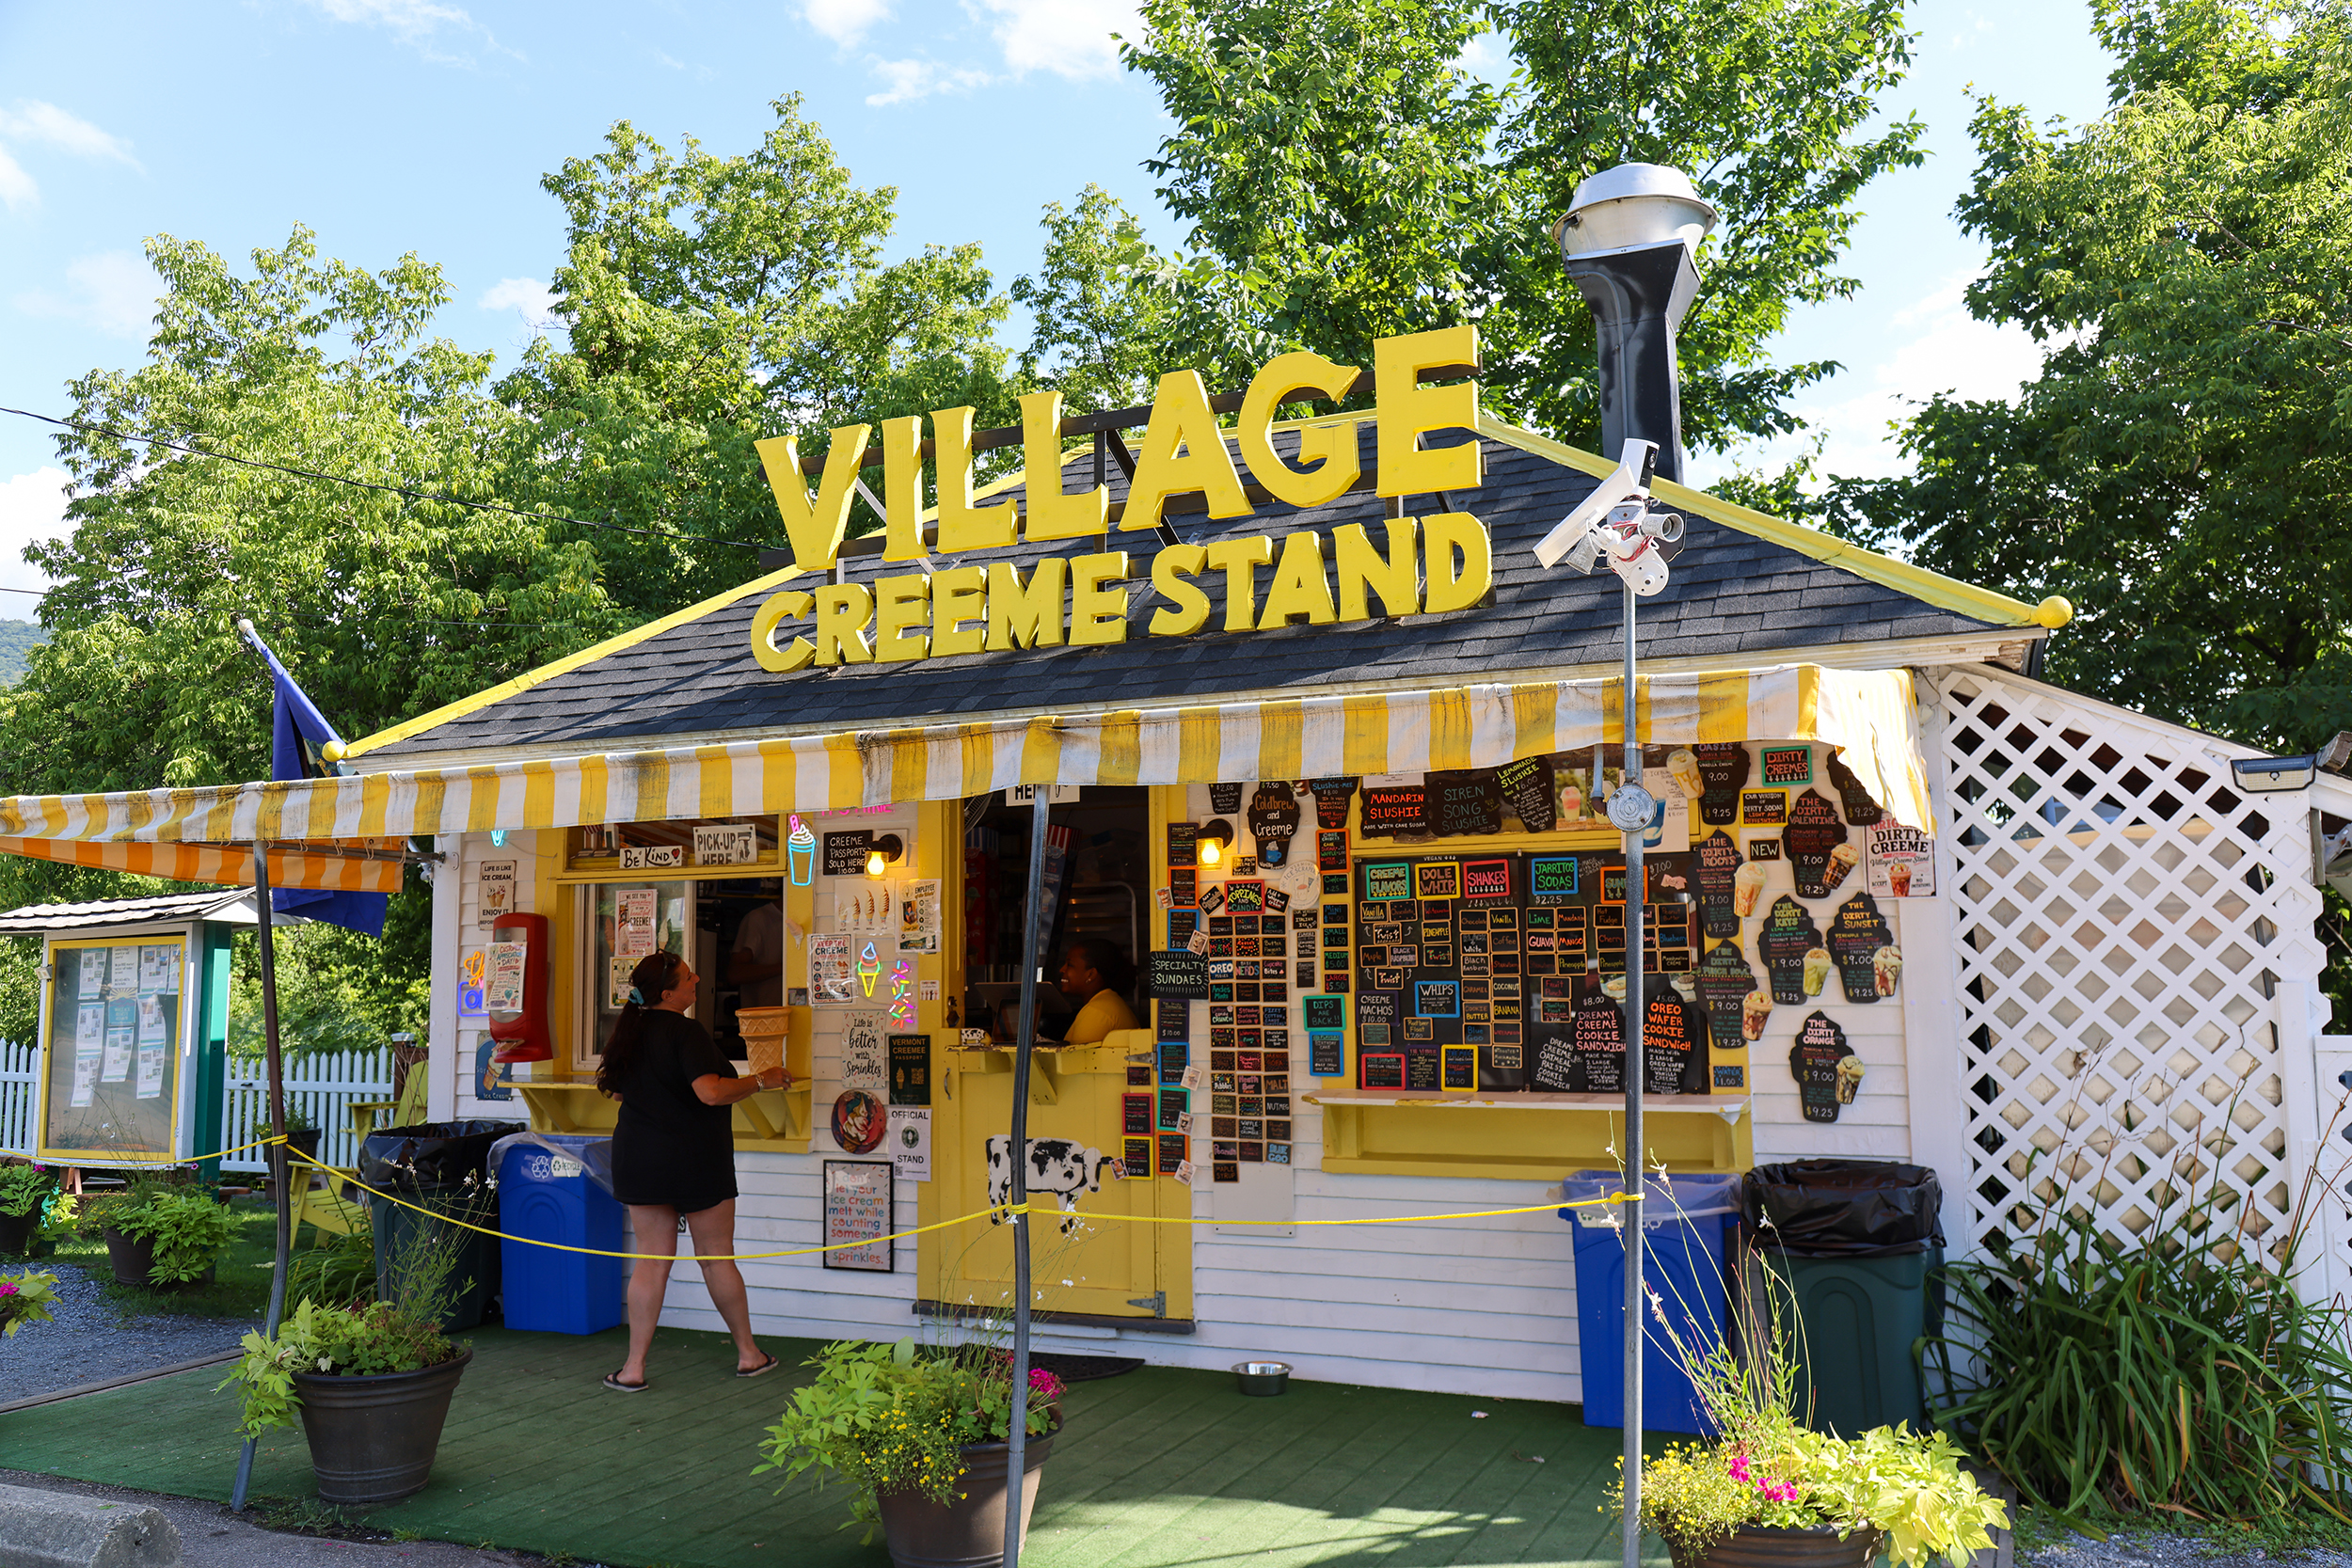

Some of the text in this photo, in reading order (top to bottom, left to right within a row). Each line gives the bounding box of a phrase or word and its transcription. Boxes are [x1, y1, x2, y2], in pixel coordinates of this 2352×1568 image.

[754, 325, 1482, 571] VILLAGE
[752, 511, 1493, 673] CREEME STAND
[1698, 742, 1733, 752] OASIS
[1766, 751, 1804, 763] DIRTY
[1497, 756, 1537, 779] LEMONADE
[1765, 762, 1808, 776] CREEMES
[1502, 764, 1539, 788] SLUSHIE
[1444, 785, 1485, 801] SIREN
[1255, 795, 1295, 811] Coldbrew
[1371, 793, 1424, 805] MANDARIN
[1800, 797, 1820, 807] THE
[1267, 811, 1279, 820] and
[1370, 806, 1421, 820] SLUSHIE
[1443, 802, 1482, 818] SONG
[1796, 806, 1828, 816] DIRTY
[1442, 816, 1488, 832] SLUSHIE
[1788, 816, 1836, 825] VALENTINE
[1256, 822, 1293, 836] Creeme
[1875, 829, 1923, 842] DIRTY
[697, 832, 736, 851] PICK-UP
[830, 836, 863, 847] CREEME
[1707, 837, 1727, 847] THE
[830, 847, 866, 859] PASSPORTS
[1701, 847, 1734, 858] DIRTY
[1750, 844, 1779, 857] NEW
[1870, 841, 1929, 854] CREEME
[702, 852, 732, 864] HERE
[829, 859, 865, 868] SOLD HERE
[1703, 856, 1737, 867] ROOTS
[1870, 859, 1892, 867] Village
[1913, 855, 1930, 863] Stand
[1535, 862, 1575, 875] JARRITOS
[1649, 861, 1672, 873] $7.00
[1284, 871, 1295, 879] ICE
[1370, 867, 1406, 879] CREEME
[1422, 868, 1453, 880] DOLE
[1468, 871, 1505, 886] SHAKES
[1370, 880, 1407, 894] FLAVORS
[1420, 881, 1455, 894] WHIP
[1537, 876, 1573, 889] SODAS
[915, 884, 934, 894] EMPLOYEE
[1228, 889, 1263, 905] TOPPINGS
[1535, 895, 1563, 905] $2.25
[1775, 902, 1794, 911] THE
[1773, 909, 1802, 918] DIRTY
[1843, 911, 1870, 920] DIRTY
[630, 917, 651, 926] CREEME!
[1599, 916, 1618, 926] Fudge
[1774, 917, 1799, 927] KEYS
[1844, 920, 1879, 929] SUNSET
[1375, 928, 1400, 941] Twist
[1423, 927, 1449, 937] PINEAPPLE
[1659, 933, 1687, 942] Blueberry
[1325, 937, 1346, 945] $4.50
[1493, 936, 1517, 945] Coffee
[1529, 936, 1554, 947] GUAVA
[1558, 937, 1583, 946] MANGO
[1598, 935, 1623, 946] Cherry
[816, 946, 849, 955] CREEME
[1427, 949, 1451, 960] Twist
[1715, 947, 1733, 956] THE
[1363, 952, 1382, 961] Maple
[1710, 958, 1738, 966] DIRTY
[1155, 960, 1204, 972] SPECIALTY
[1210, 963, 1233, 974] OREO
[1326, 960, 1345, 969] $5.00
[1559, 958, 1586, 969] Pineapple
[1600, 959, 1624, 968] Pineapple
[1236, 966, 1260, 975] NERDS
[1156, 974, 1202, 984] SUNDAES
[1378, 972, 1401, 984] Twist
[1326, 982, 1345, 990] $5.50
[1420, 984, 1454, 996] WHIPS
[1545, 980, 1564, 989] Fruit
[1313, 1001, 1334, 1009] DIPS
[1360, 995, 1391, 1005] CREEME
[1583, 996, 1605, 1006] $8.00
[1359, 1006, 1393, 1016] NACHOS
[1422, 1006, 1447, 1014] $8.00
[1494, 1005, 1520, 1015] BANANA
[1650, 1002, 1681, 1015] OREO
[1312, 1016, 1340, 1025] BACK!!
[1578, 1010, 1616, 1021] DREAMY
[1647, 1013, 1683, 1026] WAFER
[854, 1019, 866, 1027] Life
[1577, 1021, 1618, 1030] CREEME
[1807, 1019, 1827, 1028] THE
[1643, 1024, 1684, 1037] COOKIE
[1807, 1028, 1836, 1037] DIRTY
[850, 1028, 878, 1049] better
[1576, 1032, 1620, 1041] COOKIE
[1803, 1036, 1836, 1045] ORANGE
[1549, 1037, 1575, 1052] DREAMY
[1576, 1041, 1627, 1052] SANDWICH
[1542, 1043, 1572, 1060] CREEME
[1539, 1051, 1571, 1068] OATMEAL
[846, 1060, 882, 1078] Sprinkles
[1540, 1060, 1569, 1074] RAISIN
[1537, 1067, 1564, 1082] COOKIE
[1265, 1079, 1288, 1090] MALT
[1535, 1073, 1570, 1090] SANDWICH
[892, 1111, 929, 1119] OFFICIAL
[1213, 1144, 1236, 1155] Peanuts
[1269, 1144, 1288, 1154] BLUE
[897, 1155, 924, 1164] STAND
[1268, 1153, 1288, 1163] GOO
[836, 1184, 877, 1196] let your
[831, 1195, 883, 1206] ice cream
[828, 1207, 884, 1217] melt while
[832, 1218, 880, 1230] counting
[831, 1229, 882, 1239] someone
[834, 1251, 883, 1265] sprinkles.
